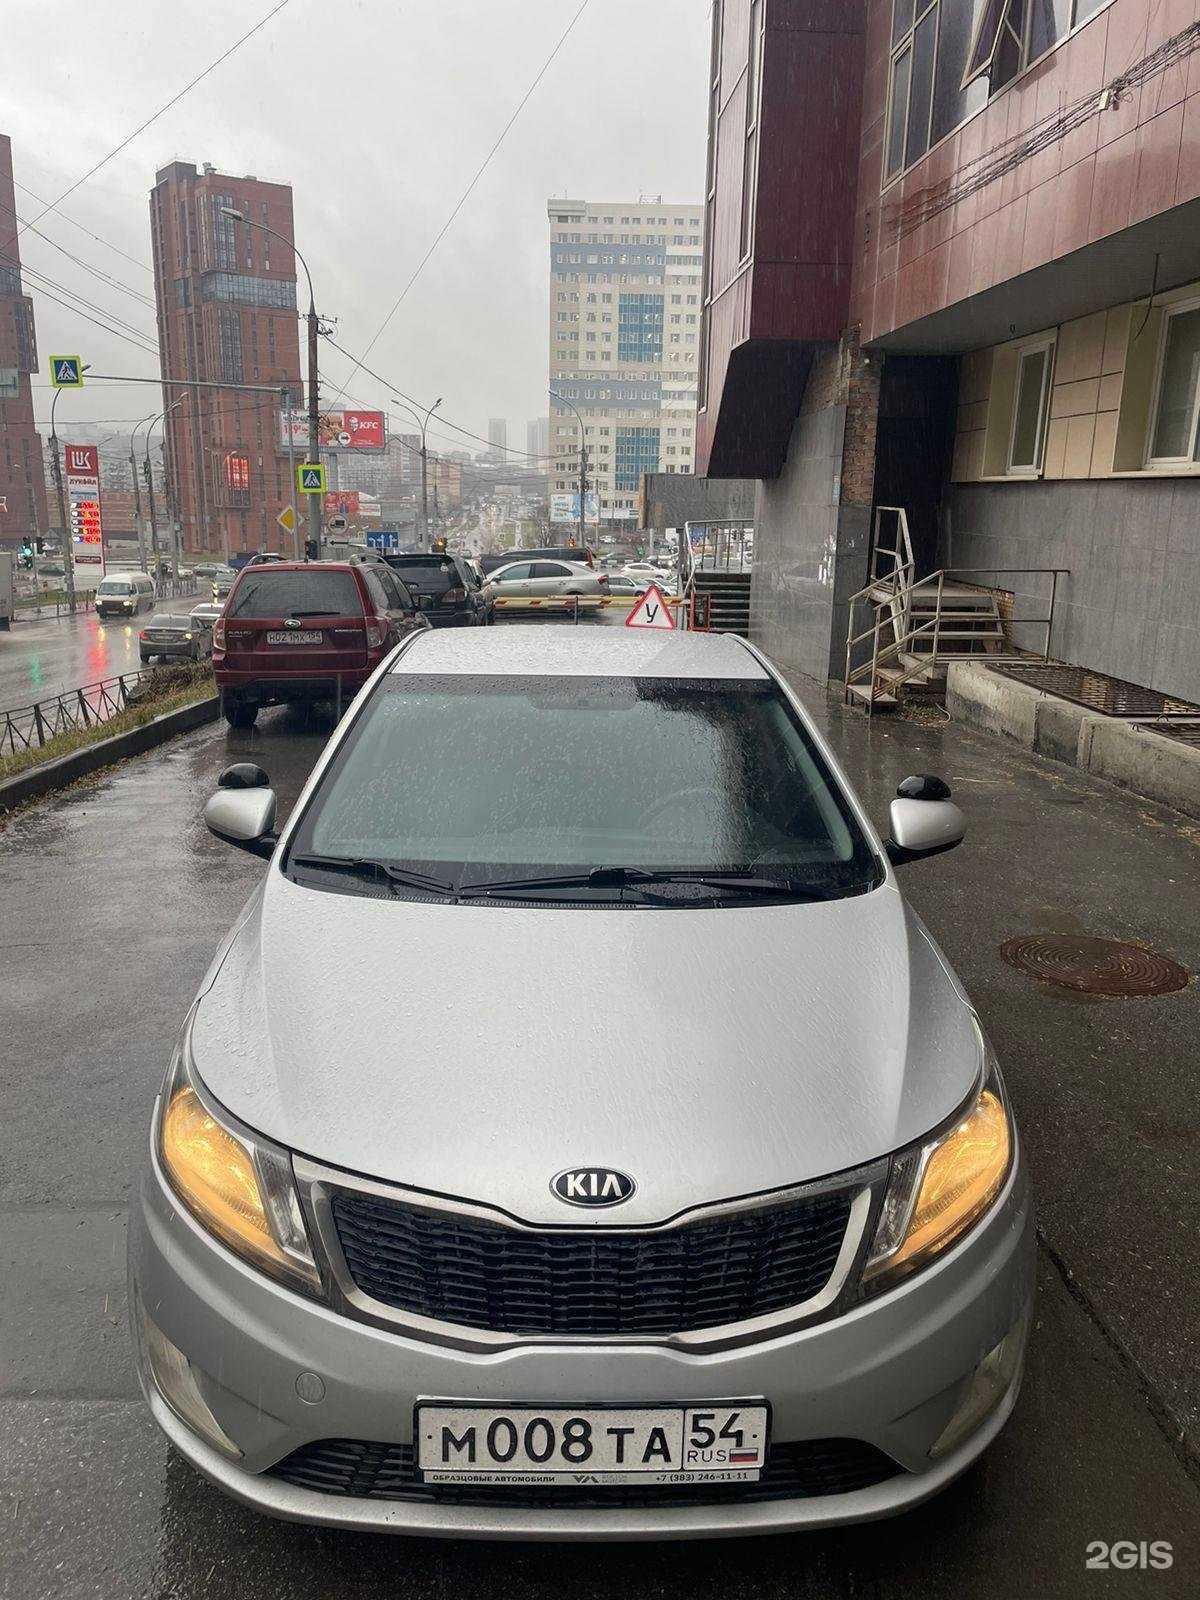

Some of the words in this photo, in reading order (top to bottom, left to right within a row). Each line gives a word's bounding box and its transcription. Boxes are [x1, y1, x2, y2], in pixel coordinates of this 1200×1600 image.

[566, 1173, 623, 1197] KIA
[690, 1412, 744, 1449] 54
[687, 1450, 727, 1463] RUS
[432, 1474, 493, 1482] ОБРАЗЦОВЫЕ
[494, 1475, 555, 1483] АВТОМОБИЛИ
